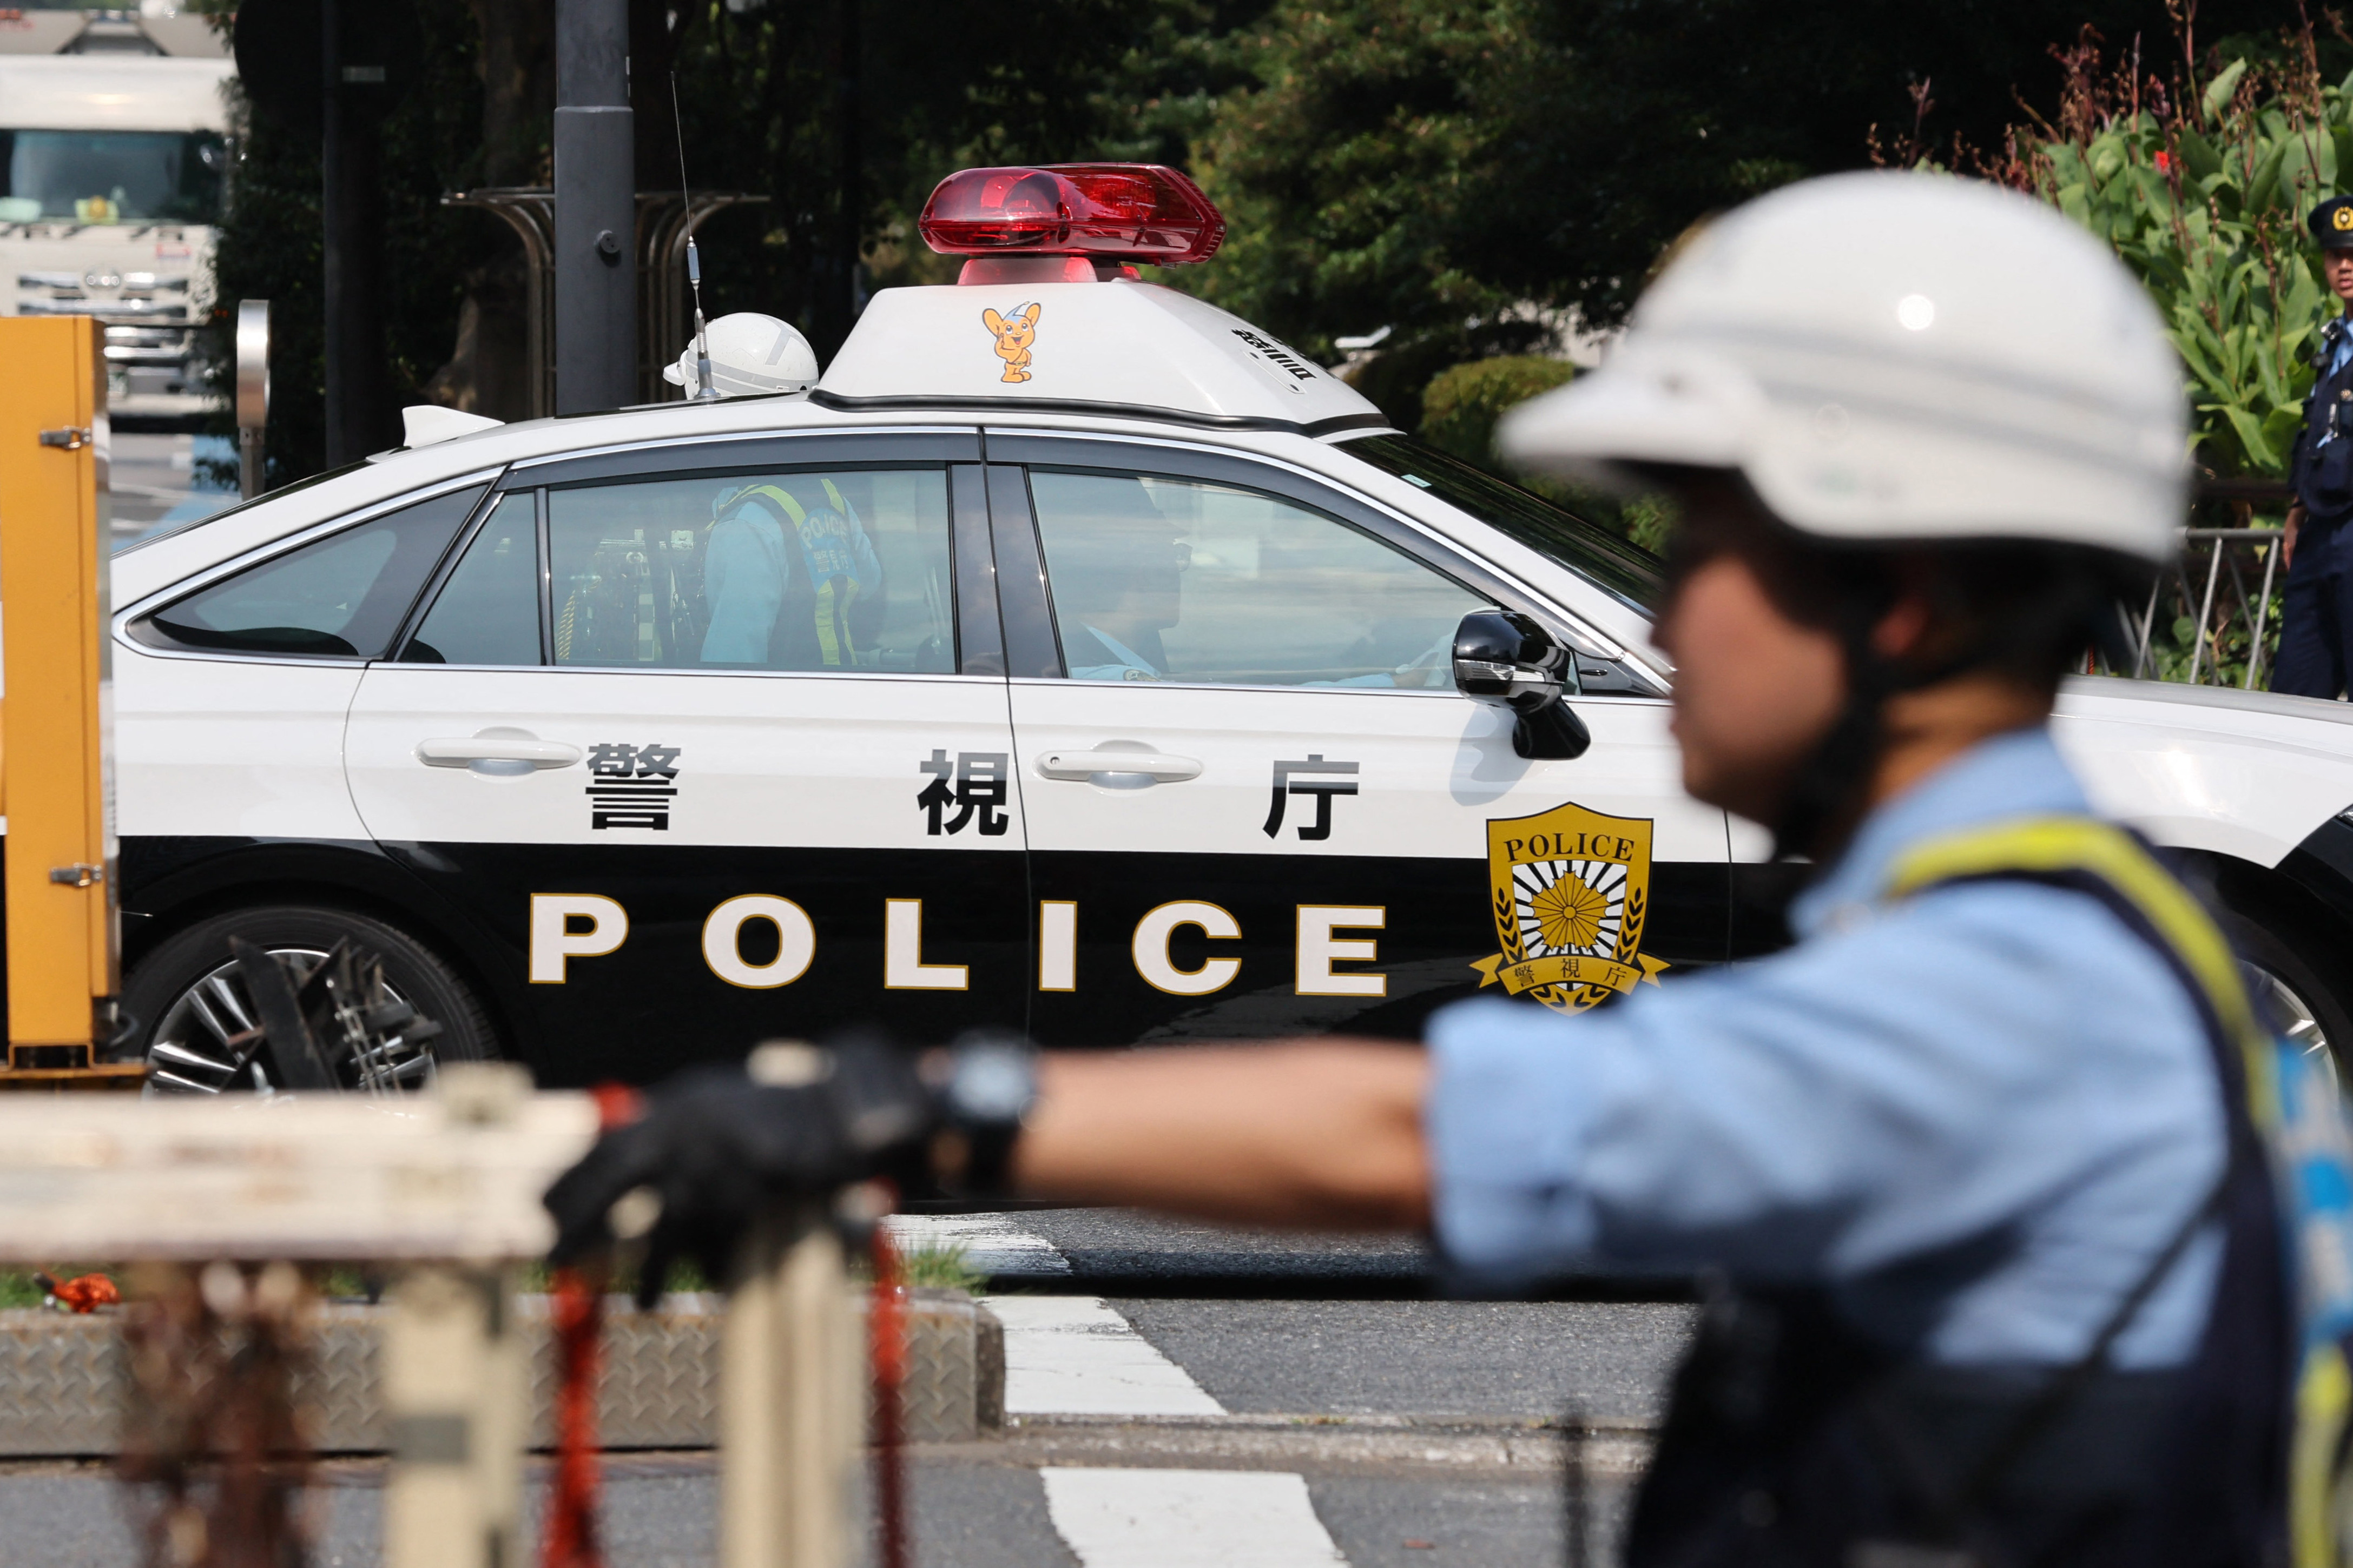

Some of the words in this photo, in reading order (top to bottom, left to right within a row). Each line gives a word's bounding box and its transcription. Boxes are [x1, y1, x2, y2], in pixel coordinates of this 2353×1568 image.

[585, 743, 1360, 840] 警視庁
[1504, 833, 1634, 863] POLICE
[529, 892, 1386, 996] POLICE
[1514, 958, 1627, 987] 警視庁
